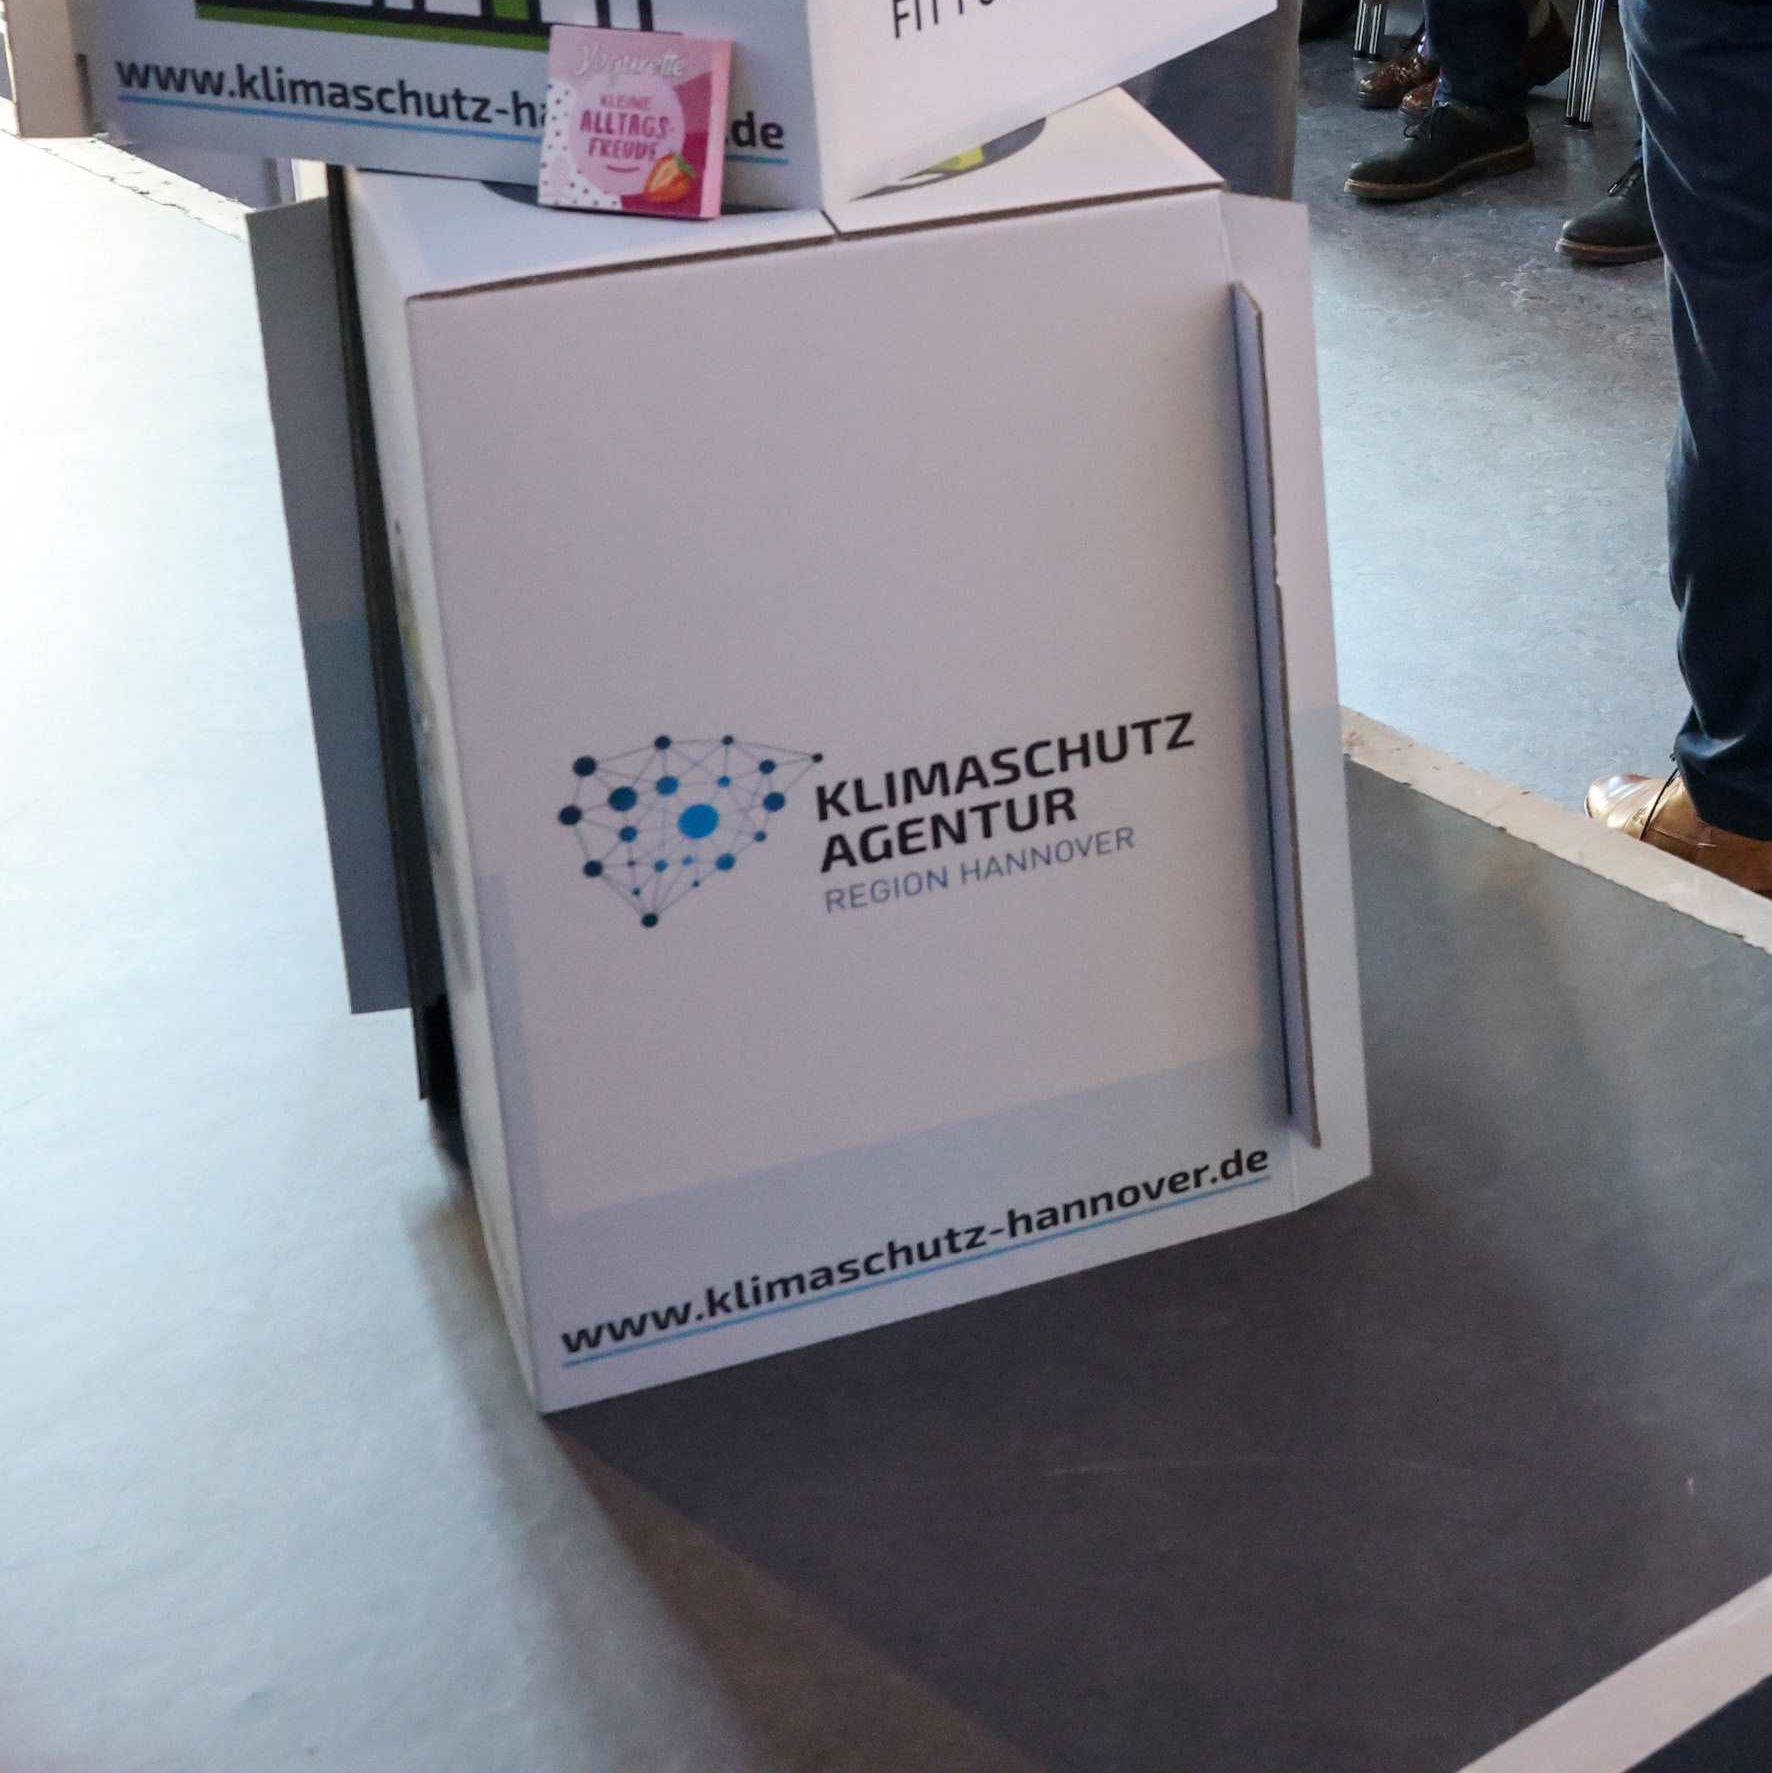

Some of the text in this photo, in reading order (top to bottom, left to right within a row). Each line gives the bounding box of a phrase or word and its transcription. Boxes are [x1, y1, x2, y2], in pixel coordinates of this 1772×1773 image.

[576, 42, 687, 85] Yogurette
[600, 94, 654, 111] KLEINE
[588, 137, 659, 162] FREUDE
[816, 712, 1195, 822] KLIMASCHUTZ
[820, 786, 1077, 873] AGENTUR
[825, 826, 1135, 914] REGION HANNOVER
[561, 1148, 1269, 1355] www.klimaschutz-hannover.de
